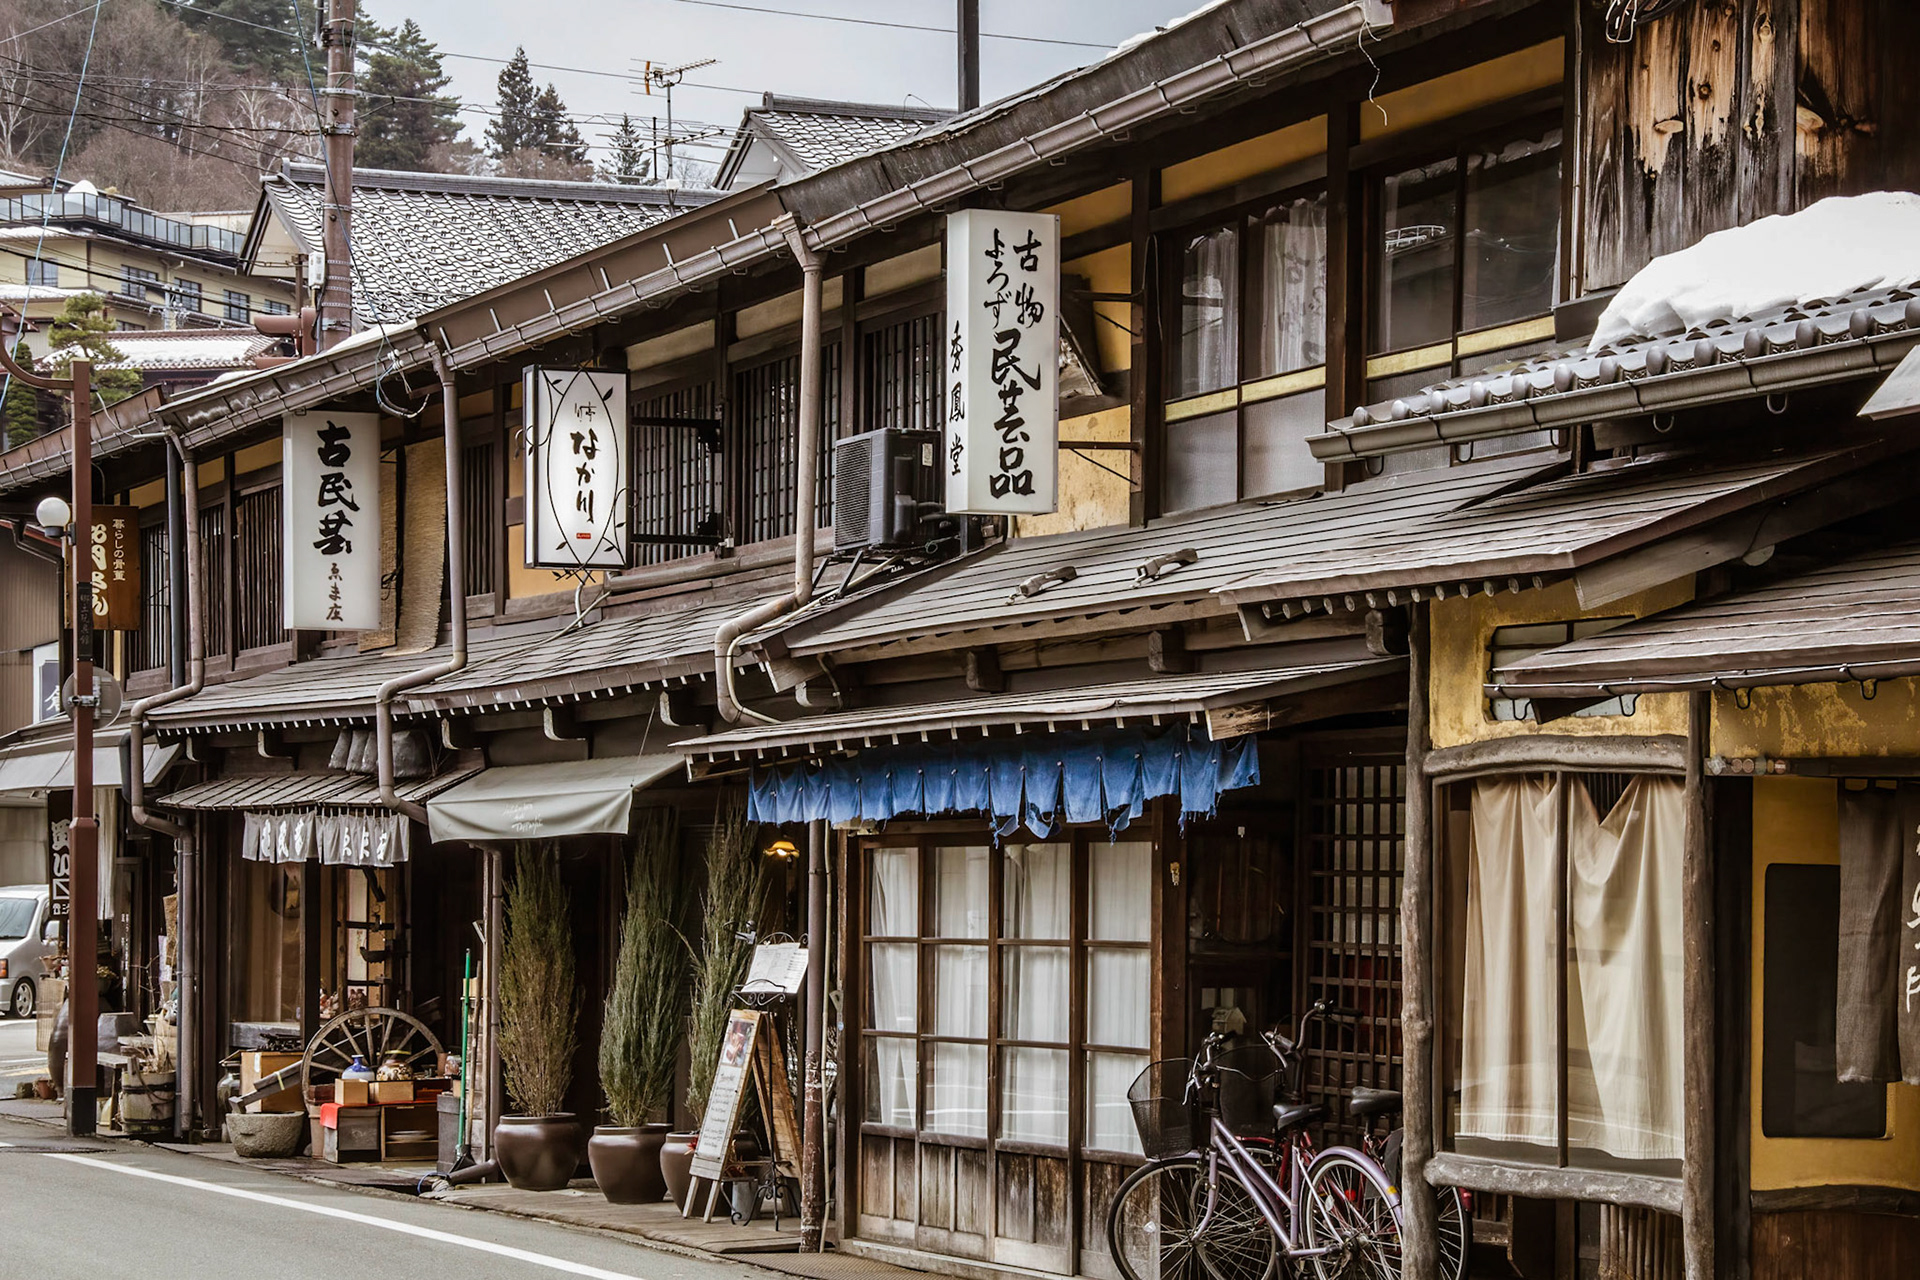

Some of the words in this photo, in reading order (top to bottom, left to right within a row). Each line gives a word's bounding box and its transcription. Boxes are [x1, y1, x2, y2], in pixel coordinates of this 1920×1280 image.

[983, 227, 1012, 329] よろず
[1013, 229, 1045, 329] 古物
[989, 328, 1041, 500] 民芸品
[313, 420, 360, 556] 古民芸
